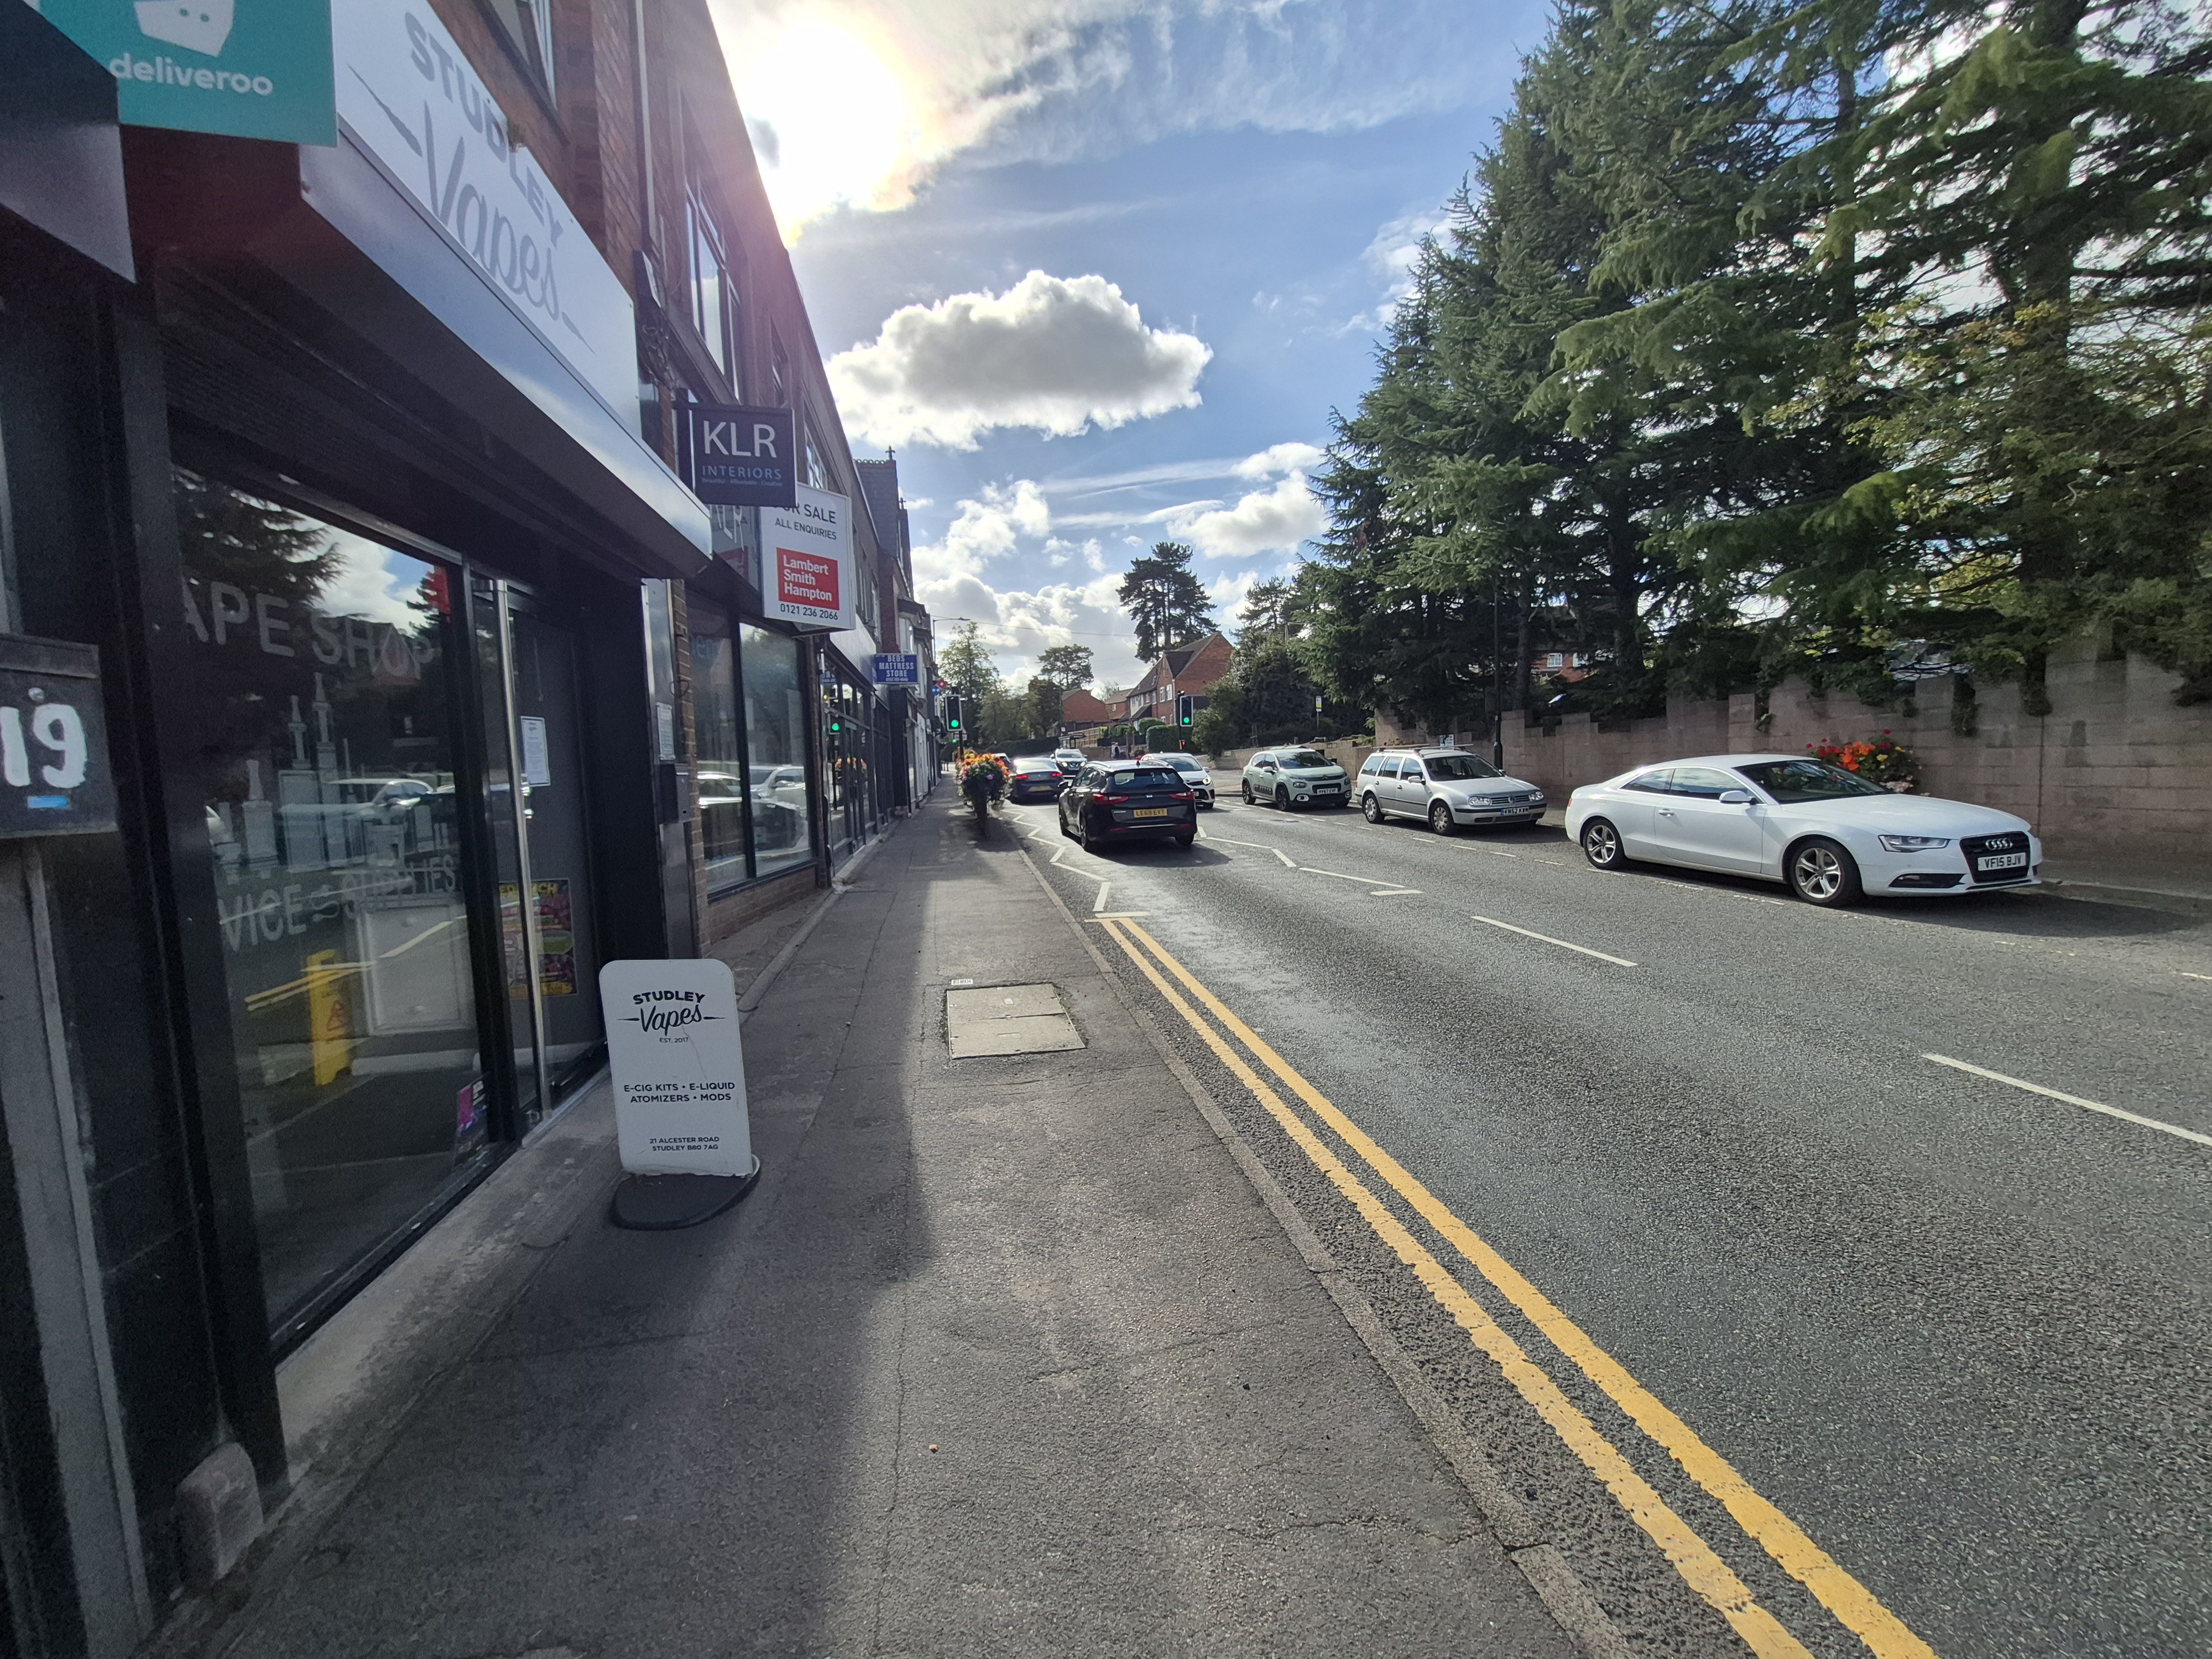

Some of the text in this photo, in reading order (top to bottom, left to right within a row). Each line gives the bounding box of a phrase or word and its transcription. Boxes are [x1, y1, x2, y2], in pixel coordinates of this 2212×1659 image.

[109, 53, 273, 96] deliveroo
[405, 12, 564, 249] STUDLEY
[424, 100, 559, 321] Vapes
[703, 420, 777, 458] KLR
[702, 465, 781, 480] INTERIORS
[804, 504, 836, 524] SALE
[775, 518, 837, 540] ALL ENQUIRIES
[783, 555, 829, 575] Lambert
[784, 569, 816, 586] Smith
[784, 582, 832, 602] Hampton
[180, 570, 295, 658] APE
[780, 603, 838, 620] 0121 236 2066
[0, 703, 87, 789] 19
[1984, 857, 2005, 868] VF15
[217, 884, 307, 953] VICE
[633, 990, 706, 1005] STUDLEY
[640, 1004, 702, 1036] Vapes
[624, 1082, 735, 1092] E-CIG KITS E-LIQUID
[630, 1093, 731, 1103] ATOMIZERS MODS
